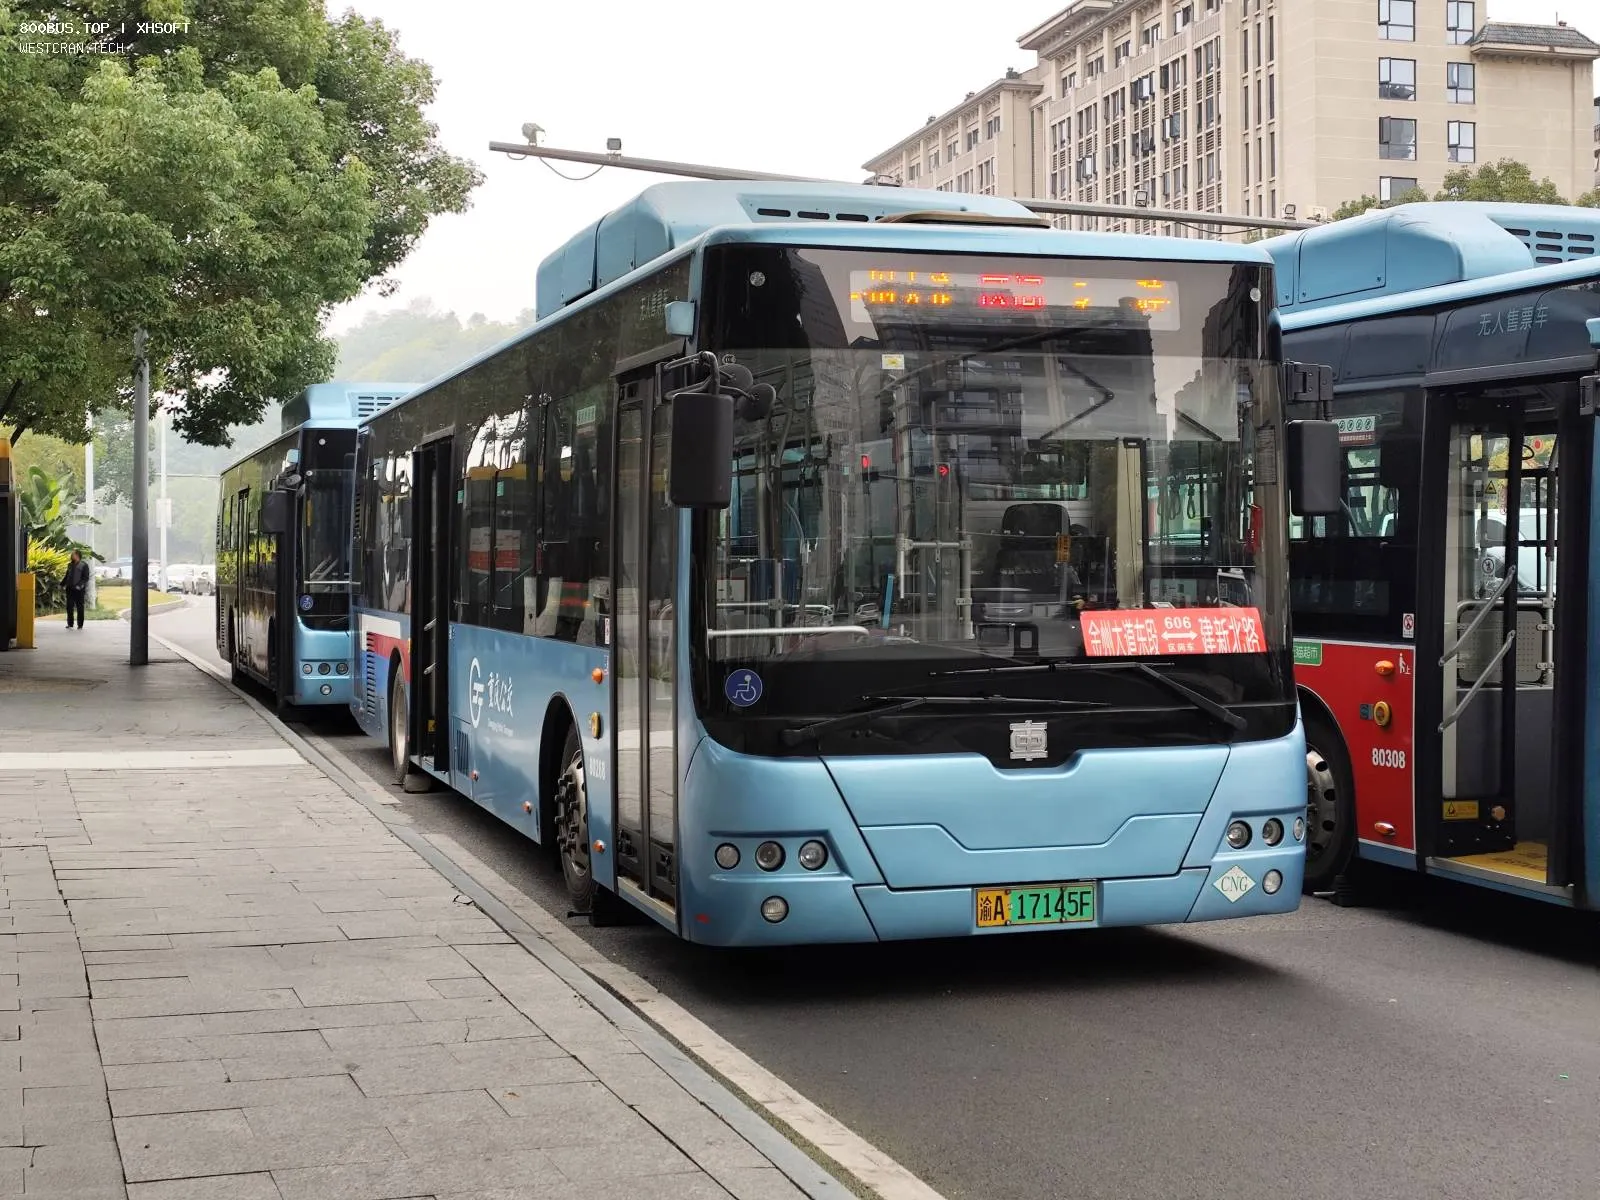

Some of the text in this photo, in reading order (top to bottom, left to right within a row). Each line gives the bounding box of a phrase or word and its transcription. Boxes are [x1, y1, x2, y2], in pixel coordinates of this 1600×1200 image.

[1478, 303, 1550, 337] 无人售票车
[1163, 616, 1192, 630] 606
[1198, 616, 1261, 654] 建新北路
[1371, 747, 1406, 769] 80308
[1220, 875, 1248, 893] CNG
